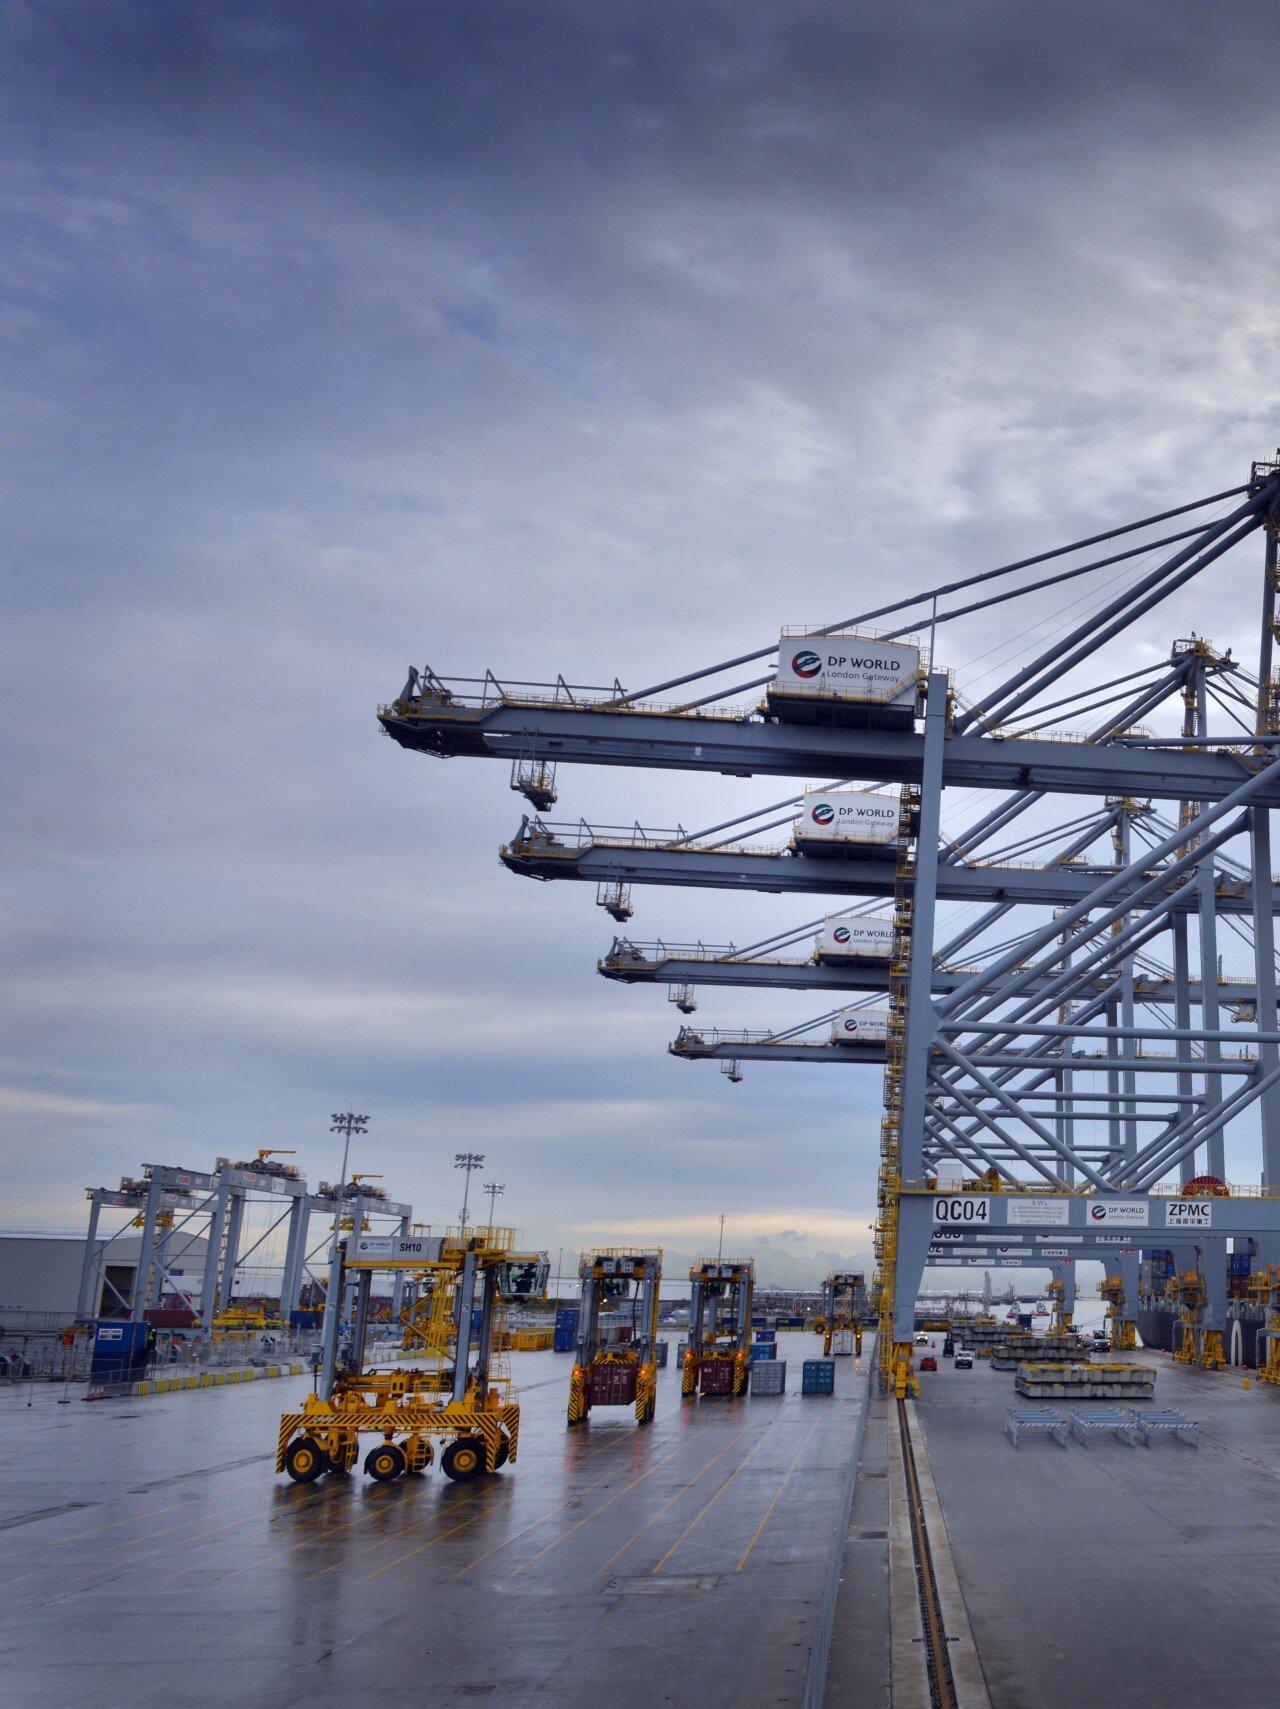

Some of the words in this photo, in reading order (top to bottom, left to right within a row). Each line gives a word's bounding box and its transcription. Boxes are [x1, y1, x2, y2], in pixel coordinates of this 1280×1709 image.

[828, 656, 846, 667] DP
[850, 658, 900, 671] WORLD
[827, 670, 859, 679] London
[862, 673, 899, 683] Gateway
[839, 807, 853, 816] DP
[856, 808, 894, 818] WORLD
[865, 819, 894, 827] Gateway
[936, 1199, 987, 1222] QC04
[1168, 1203, 1210, 1217] ZPMC
[400, 1243, 422, 1252] SH10
